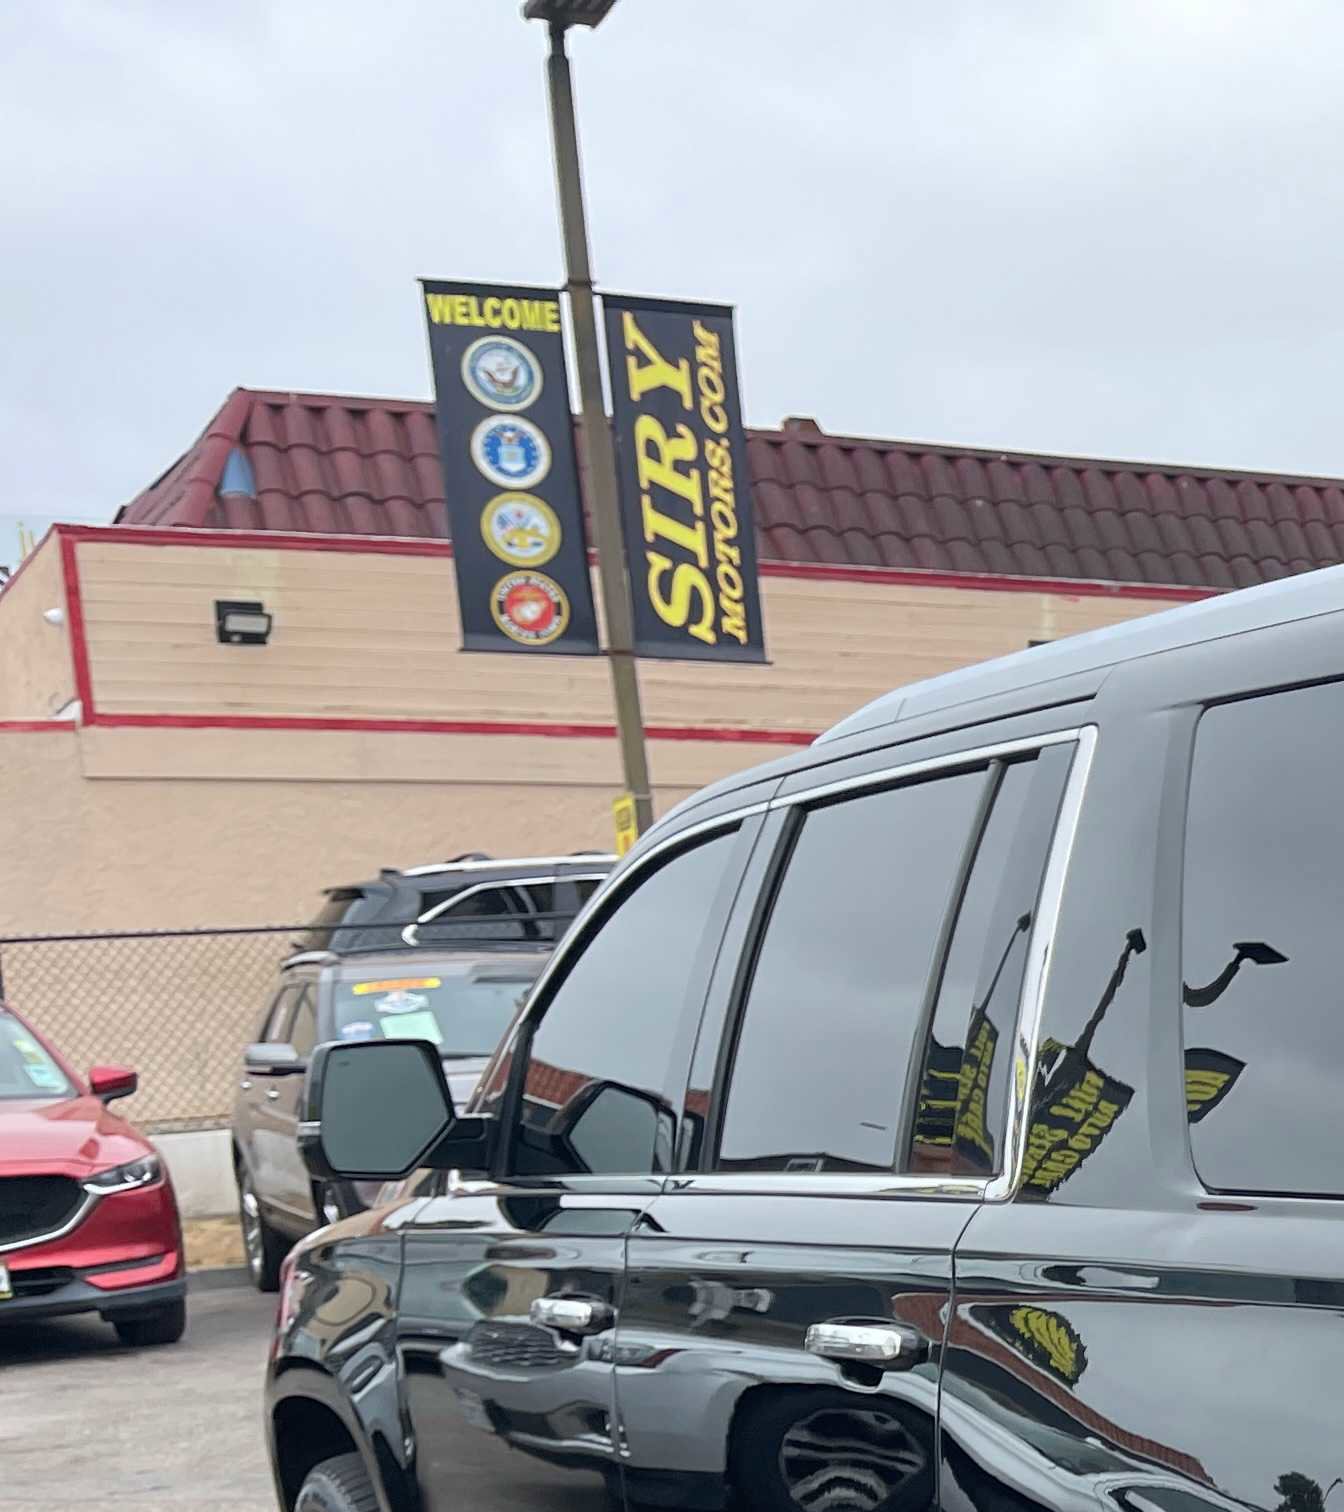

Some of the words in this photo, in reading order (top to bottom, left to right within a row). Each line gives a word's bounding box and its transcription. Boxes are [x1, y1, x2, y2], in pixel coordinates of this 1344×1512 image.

[425, 292, 561, 333] WELCOME
[622, 310, 717, 645] SIRY
[692, 319, 748, 645] MOTORS.COM
